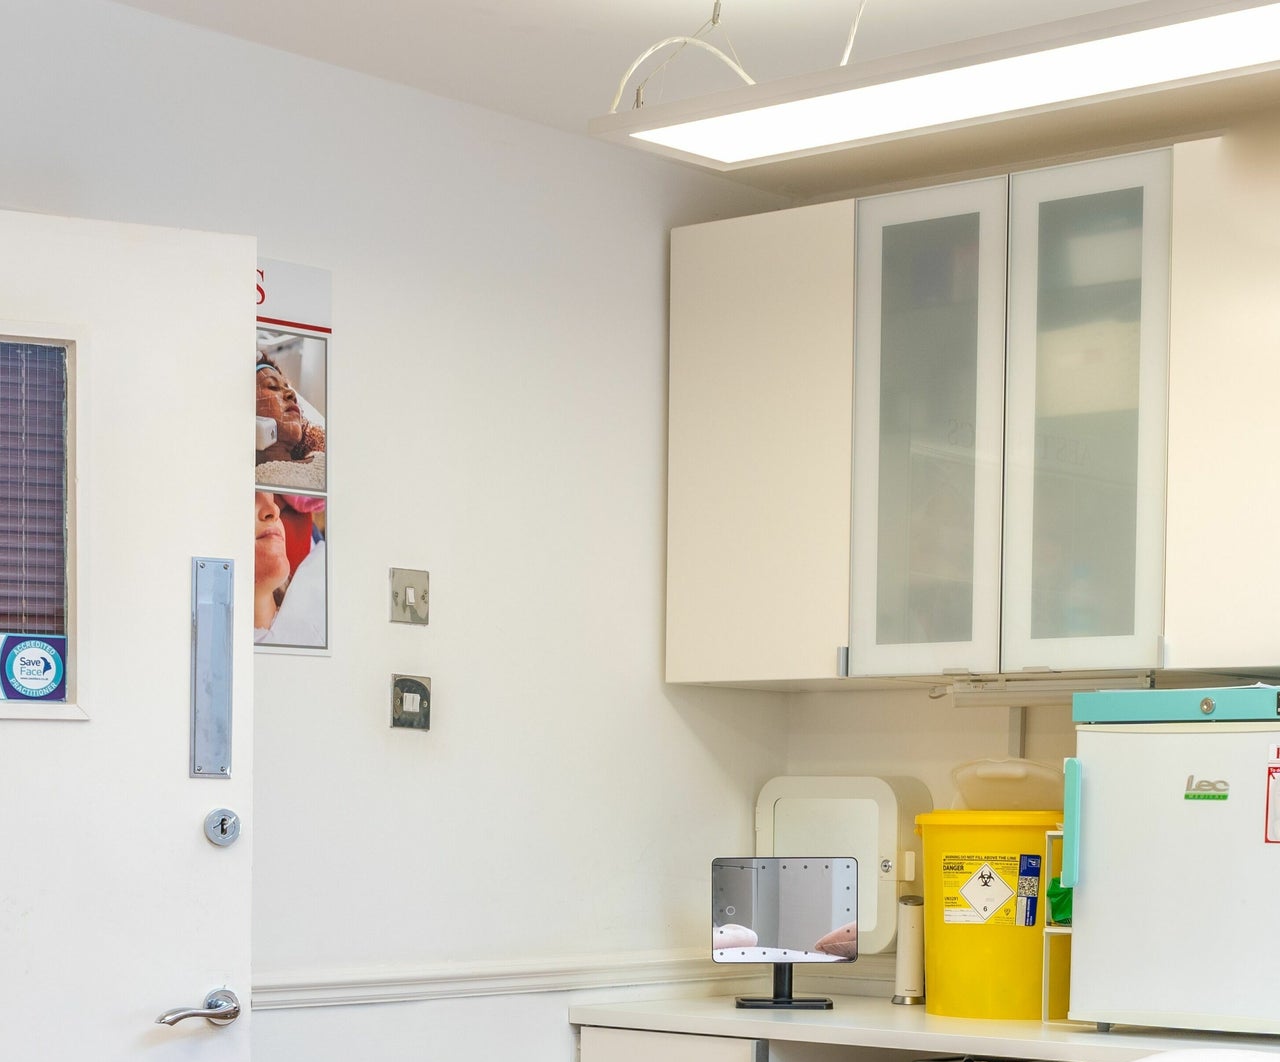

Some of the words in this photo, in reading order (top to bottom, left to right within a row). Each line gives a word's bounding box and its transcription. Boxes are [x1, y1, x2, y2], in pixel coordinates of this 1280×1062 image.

[13, 640, 56, 656] ACCREDITED
[19, 656, 41, 666] Save
[19, 667, 42, 676] Face
[10, 678, 57, 697] PRACTITIONER
[1185, 774, 1230, 792] Lec
